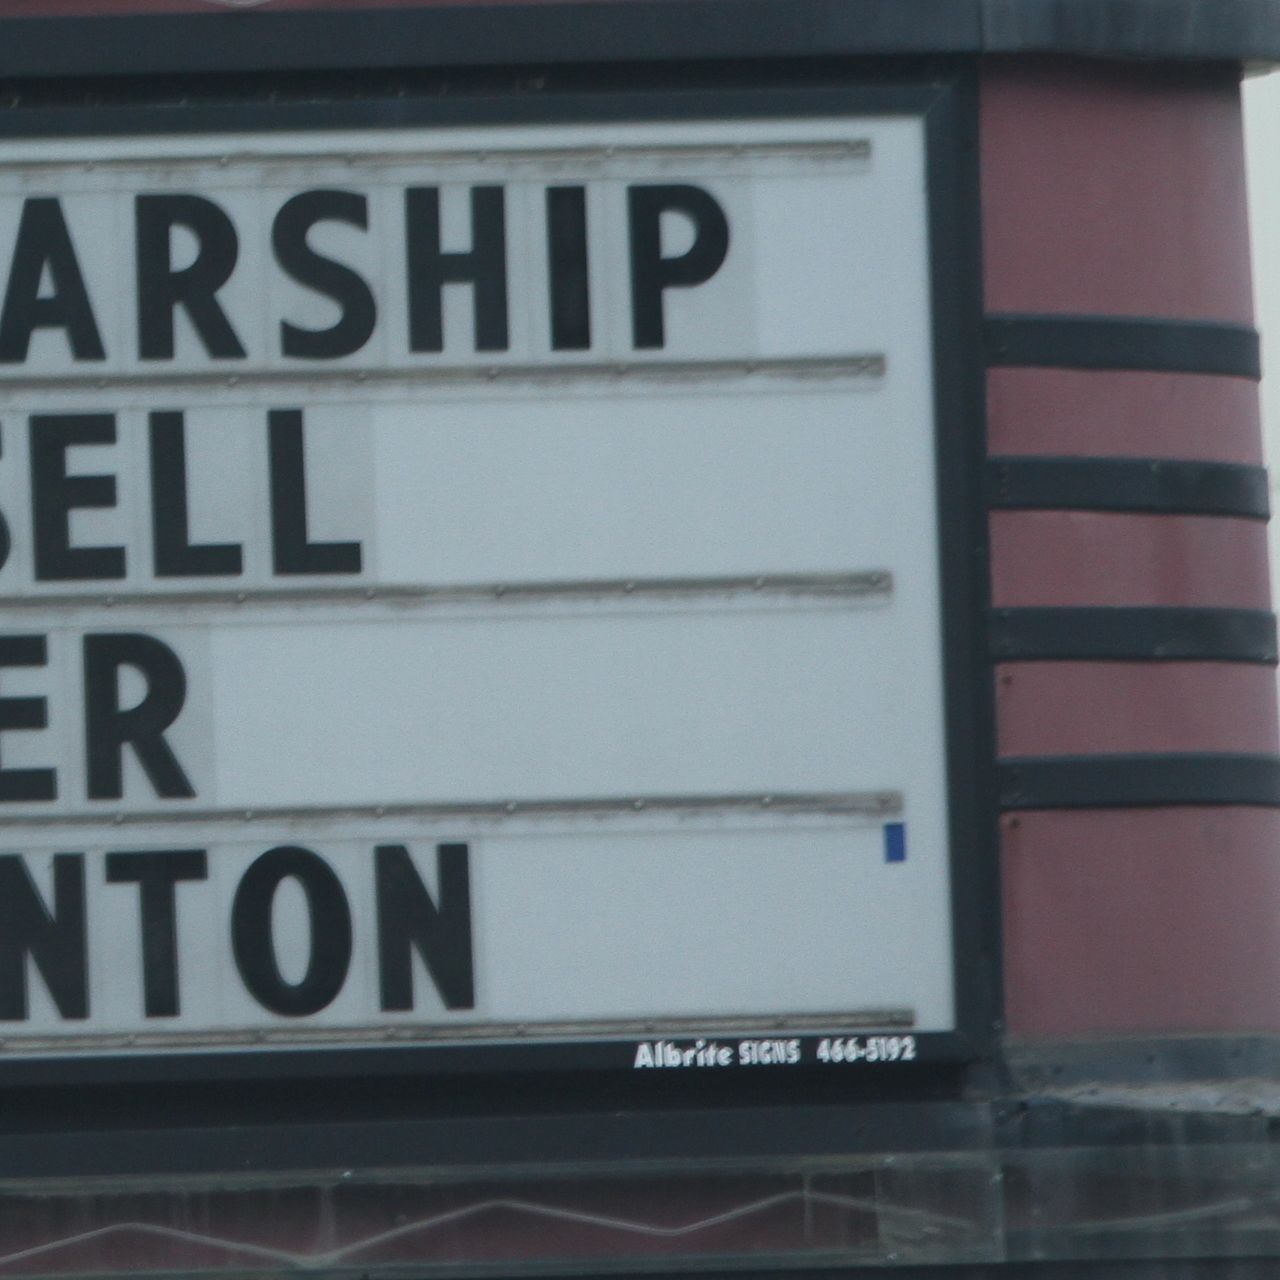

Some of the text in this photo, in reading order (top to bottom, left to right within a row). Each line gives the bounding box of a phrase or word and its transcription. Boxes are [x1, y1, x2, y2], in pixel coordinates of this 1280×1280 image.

[634, 1035, 917, 1068] Albrite SIGNS 466-5192
